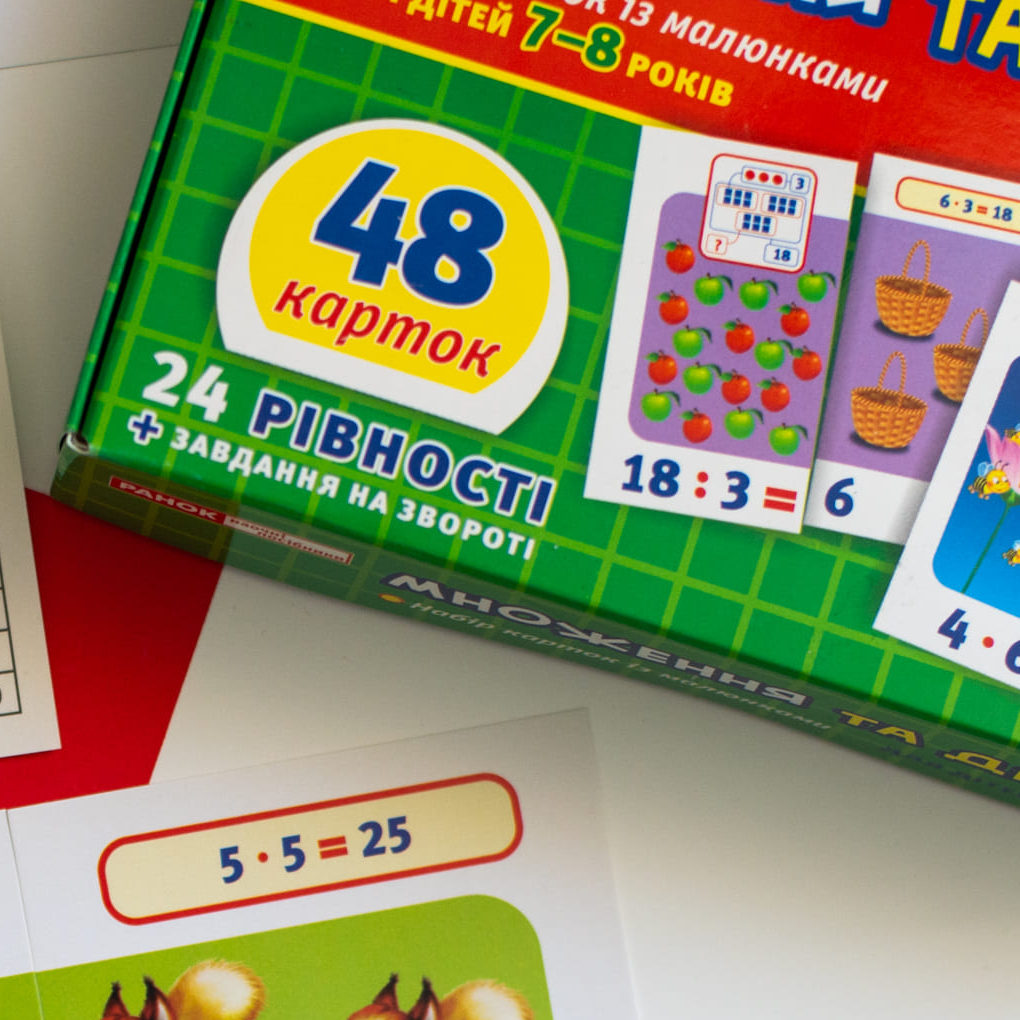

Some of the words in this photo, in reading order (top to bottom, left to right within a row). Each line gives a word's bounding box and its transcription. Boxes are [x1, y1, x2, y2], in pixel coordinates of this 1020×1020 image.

[405, 0, 514, 38] ДІТЕЙ
[626, 52, 735, 108] РОКІВ
[659, 10, 889, 103] малюнками
[795, 173, 806, 190] 3
[938, 194, 951, 208] 6
[962, 199, 974, 213] 3
[992, 204, 1014, 222] 18
[312, 157, 507, 308] 48
[773, 246, 792, 262] 18
[273, 280, 501, 378] карток
[141, 350, 230, 423] 24
[248, 387, 557, 527] РІВНОСТІ
[118, 481, 218, 521] РАНОК
[169, 427, 341, 499] ЗАВДАННЯ
[347, 483, 390, 516] НА
[396, 498, 536, 561] ЗВОРОТІ
[621, 453, 682, 498] 18
[720, 470, 752, 510] 3
[825, 476, 856, 517] 6
[386, 573, 809, 708] МНОЖЕННЯ
[839, 709, 921, 747] ТА
[409, 602, 497, 631] Набір
[502, 628, 621, 665] карток
[938, 607, 970, 651] 4
[219, 845, 243, 883] 5
[281, 834, 306, 873] 5
[358, 816, 411, 857] 25
